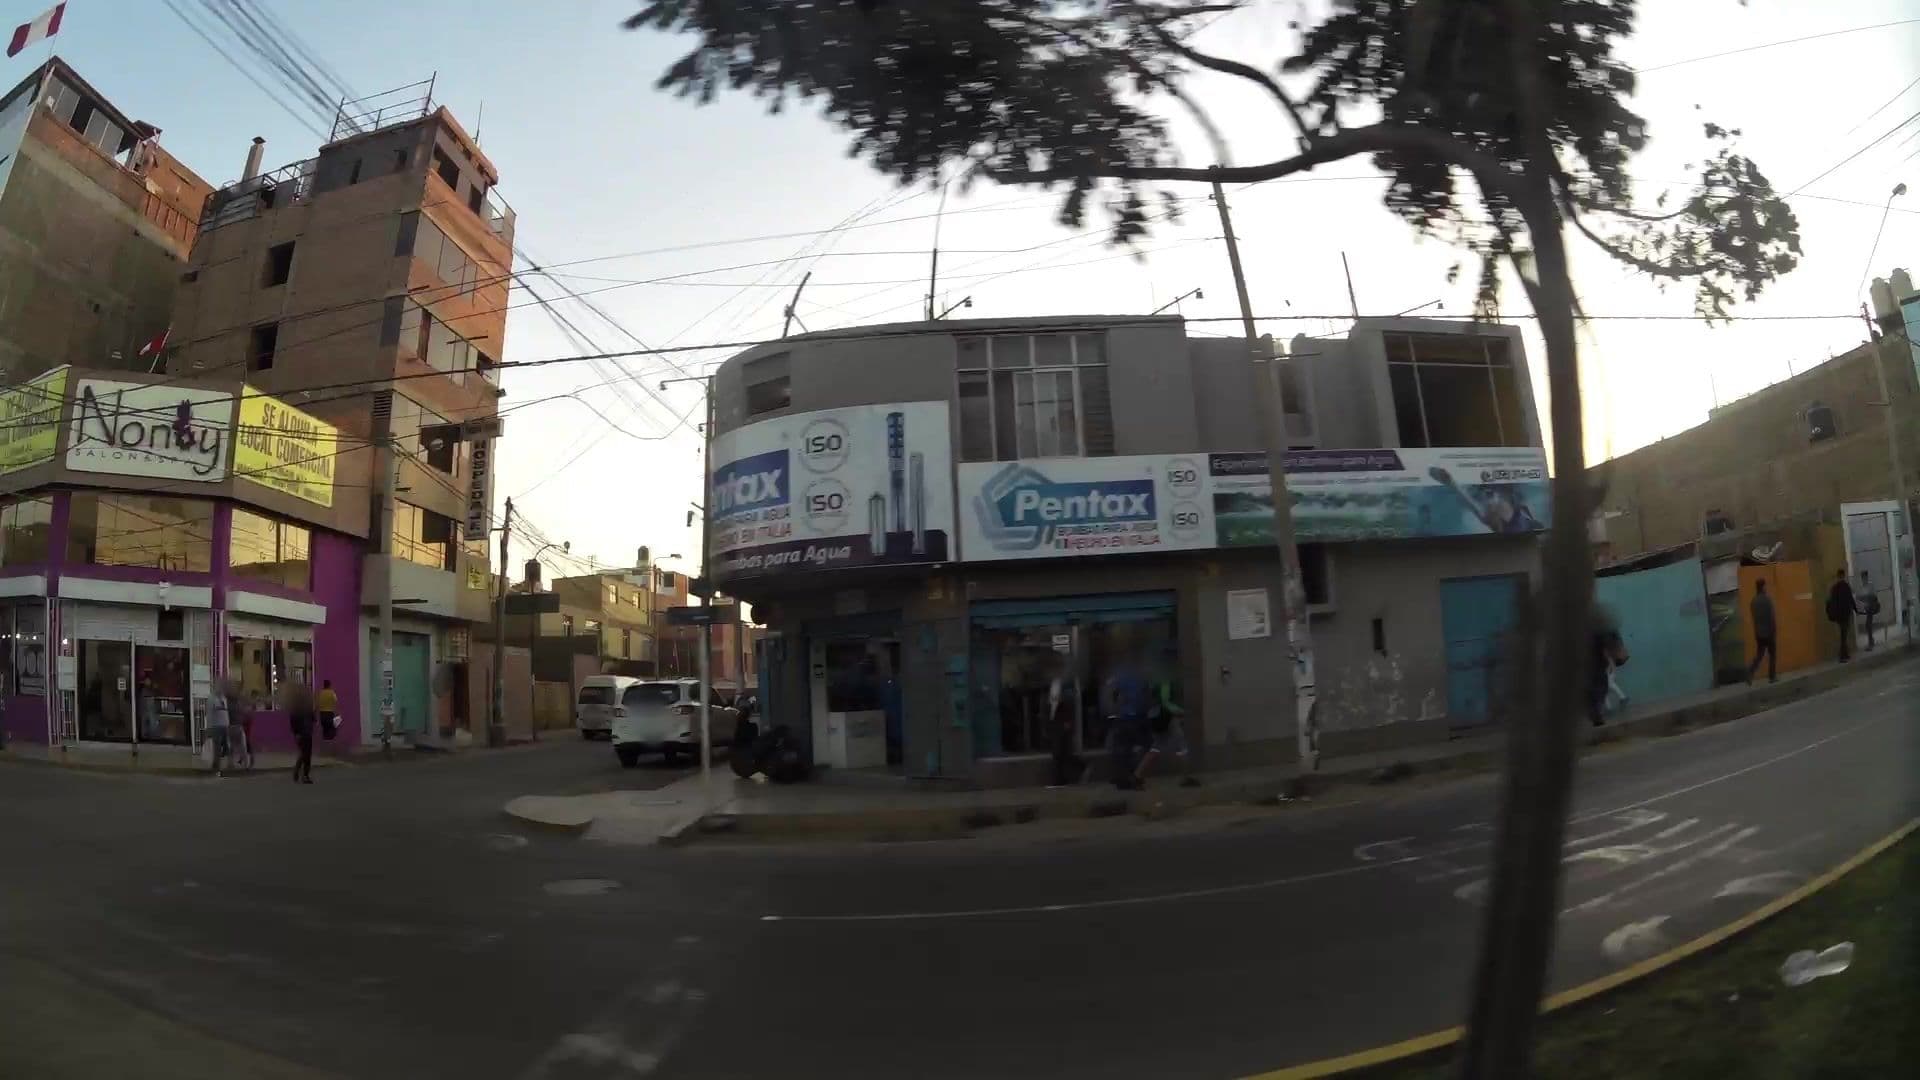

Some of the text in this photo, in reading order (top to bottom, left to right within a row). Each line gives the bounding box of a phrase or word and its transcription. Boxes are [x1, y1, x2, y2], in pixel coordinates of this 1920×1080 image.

[262, 402, 276, 428] SE
[806, 434, 842, 454] ISO
[1167, 470, 1196, 483] ISO
[806, 493, 844, 513] ISO
[1013, 489, 1149, 522] Pentax
[1171, 512, 1200, 526] ISO
[765, 551, 801, 568] para
[803, 544, 852, 565] Agua
